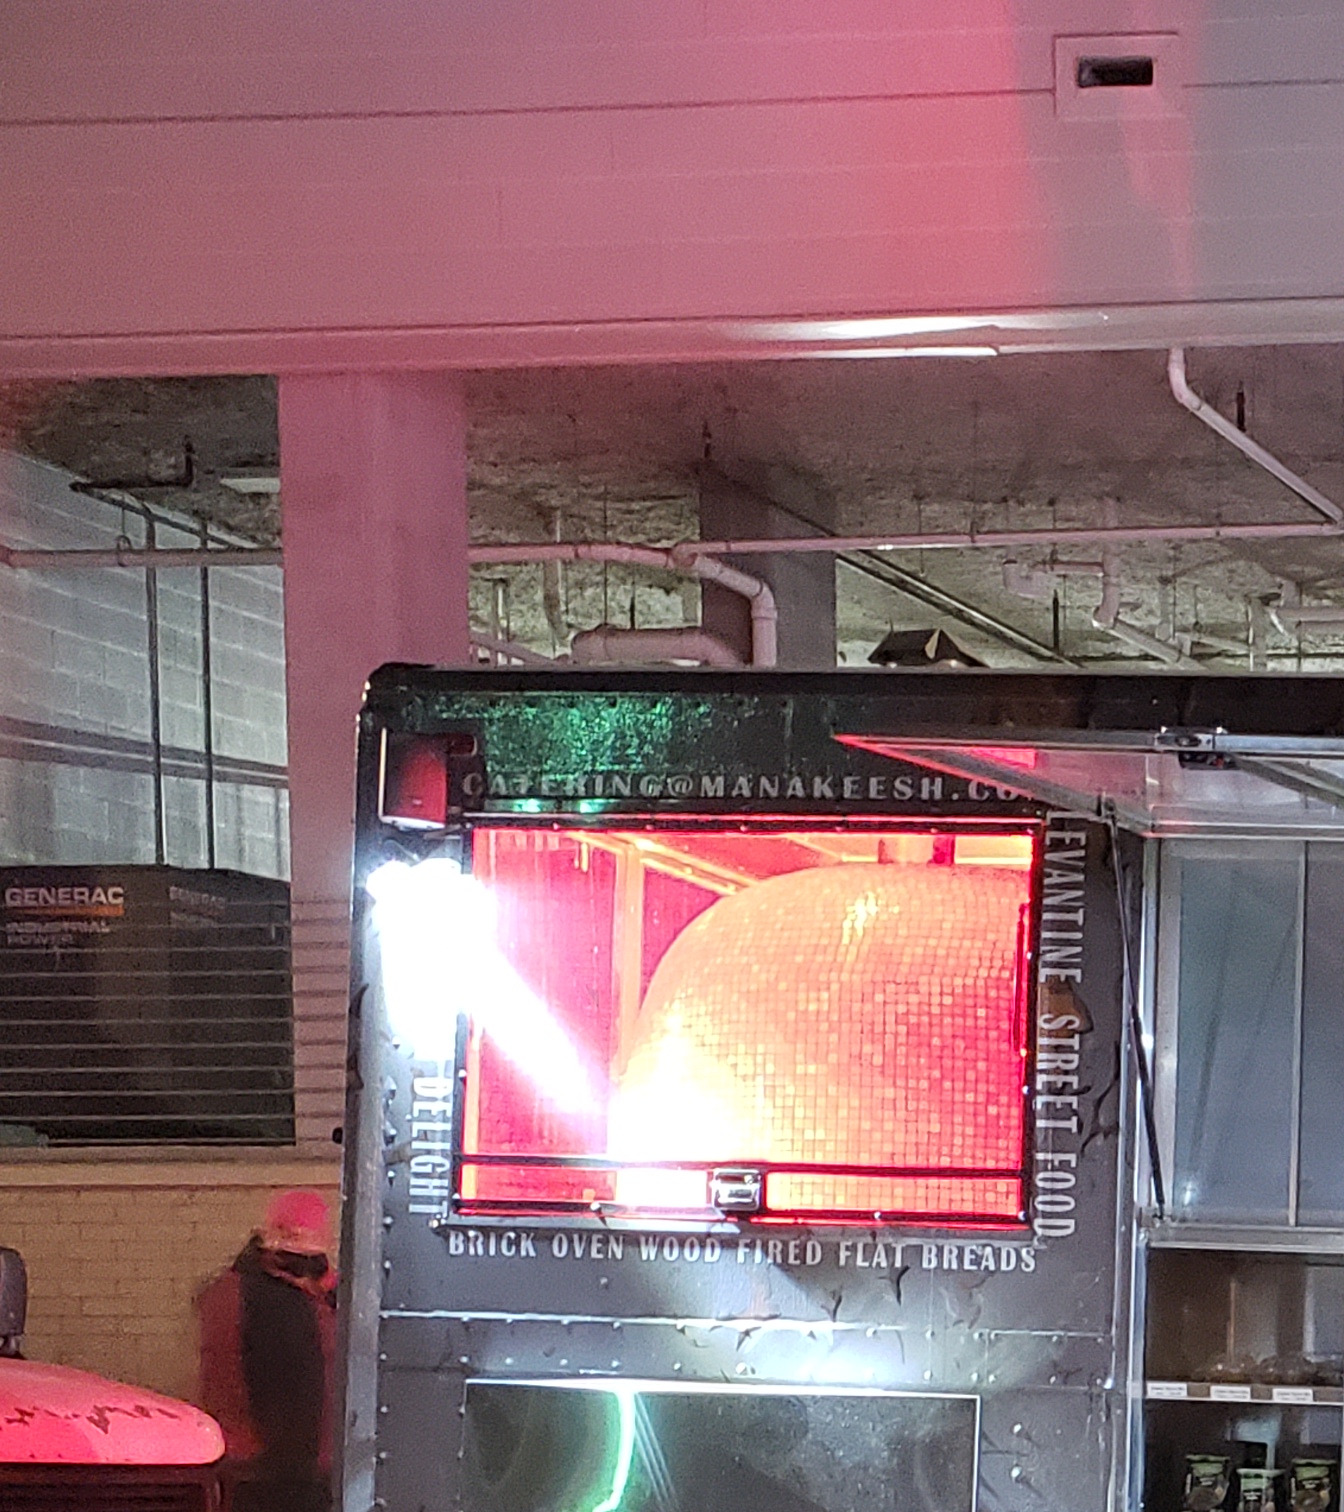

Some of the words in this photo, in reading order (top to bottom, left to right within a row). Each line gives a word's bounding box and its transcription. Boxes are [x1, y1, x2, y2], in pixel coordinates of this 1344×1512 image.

[4, 886, 125, 905] GENERAC
[1036, 810, 1088, 984] LEVANTINE
[1033, 1012, 1081, 1134] STREET
[408, 1077, 453, 1218] DELIGHT
[1033, 1152, 1077, 1239] FOOD
[449, 1230, 537, 1258] BRICK
[552, 1233, 624, 1260] OVEN
[640, 1236, 721, 1263] WOOD
[737, 1238, 822, 1266] FIRED
[838, 1241, 906, 1269] FLAT
[921, 1244, 1036, 1273] BREADS
